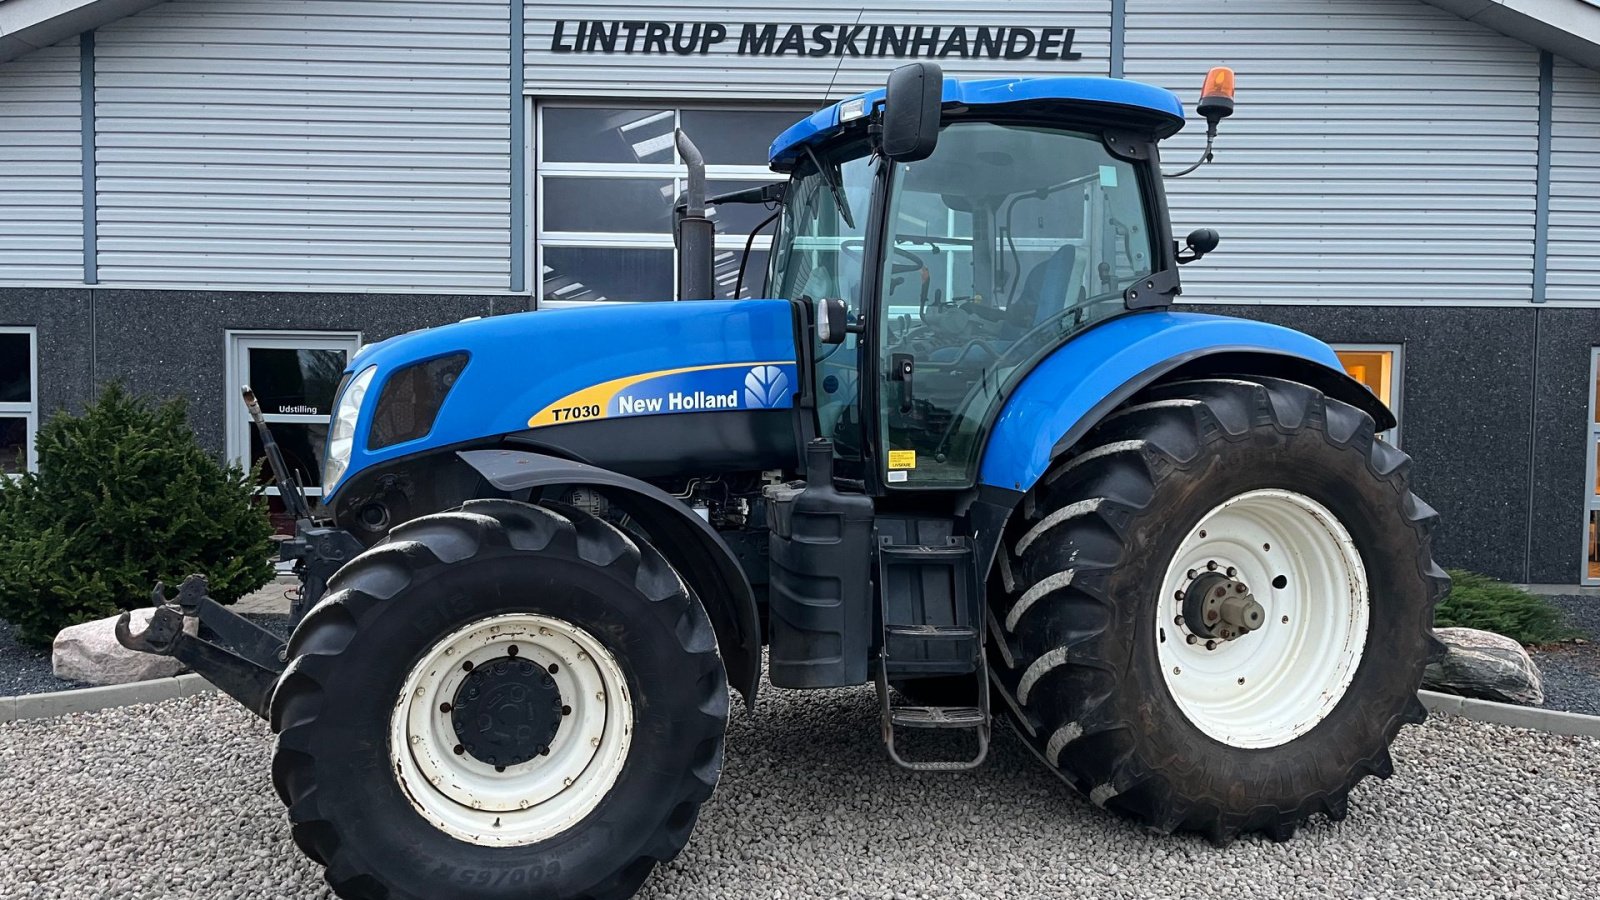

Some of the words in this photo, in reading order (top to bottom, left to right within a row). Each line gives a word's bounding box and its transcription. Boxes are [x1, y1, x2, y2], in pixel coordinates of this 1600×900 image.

[551, 20, 726, 54] LINTRUP
[738, 24, 1082, 60] MASKINHANDEL
[279, 405, 318, 414] Udstilling
[618, 396, 662, 414] New
[668, 390, 738, 410] Holland
[552, 404, 600, 421] T7030
